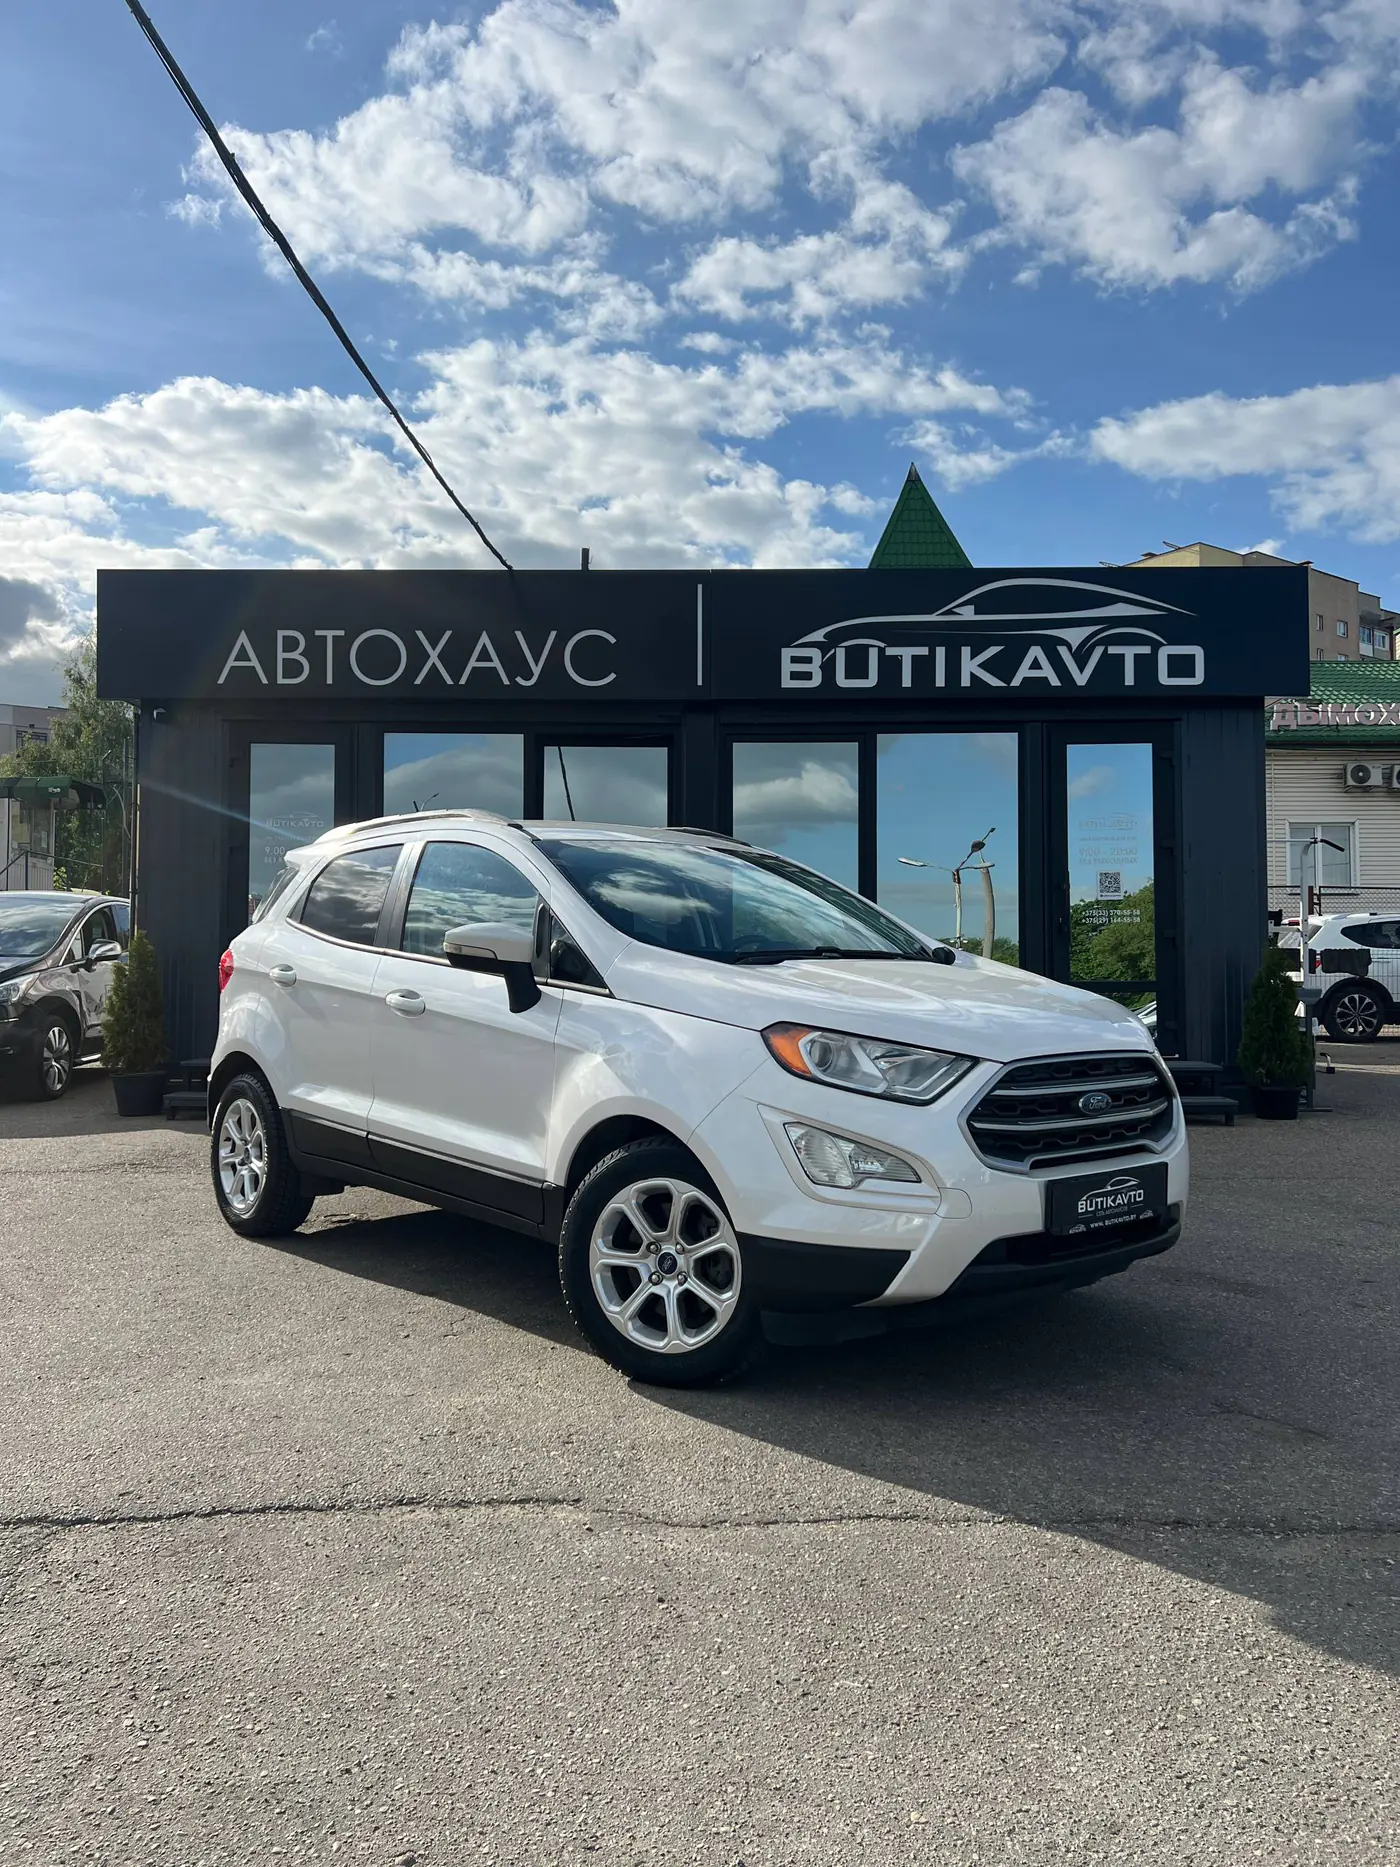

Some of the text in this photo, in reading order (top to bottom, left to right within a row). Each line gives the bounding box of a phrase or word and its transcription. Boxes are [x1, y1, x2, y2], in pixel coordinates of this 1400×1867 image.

[216, 628, 617, 687] АВТОХАУС
[780, 644, 1205, 688] BUTIKAVTO
[1269, 702, 1400, 731] ДЫМОХ
[1090, 1096, 1107, 1110] Ford
[1078, 1190, 1144, 1213] BUTIKAVTO
